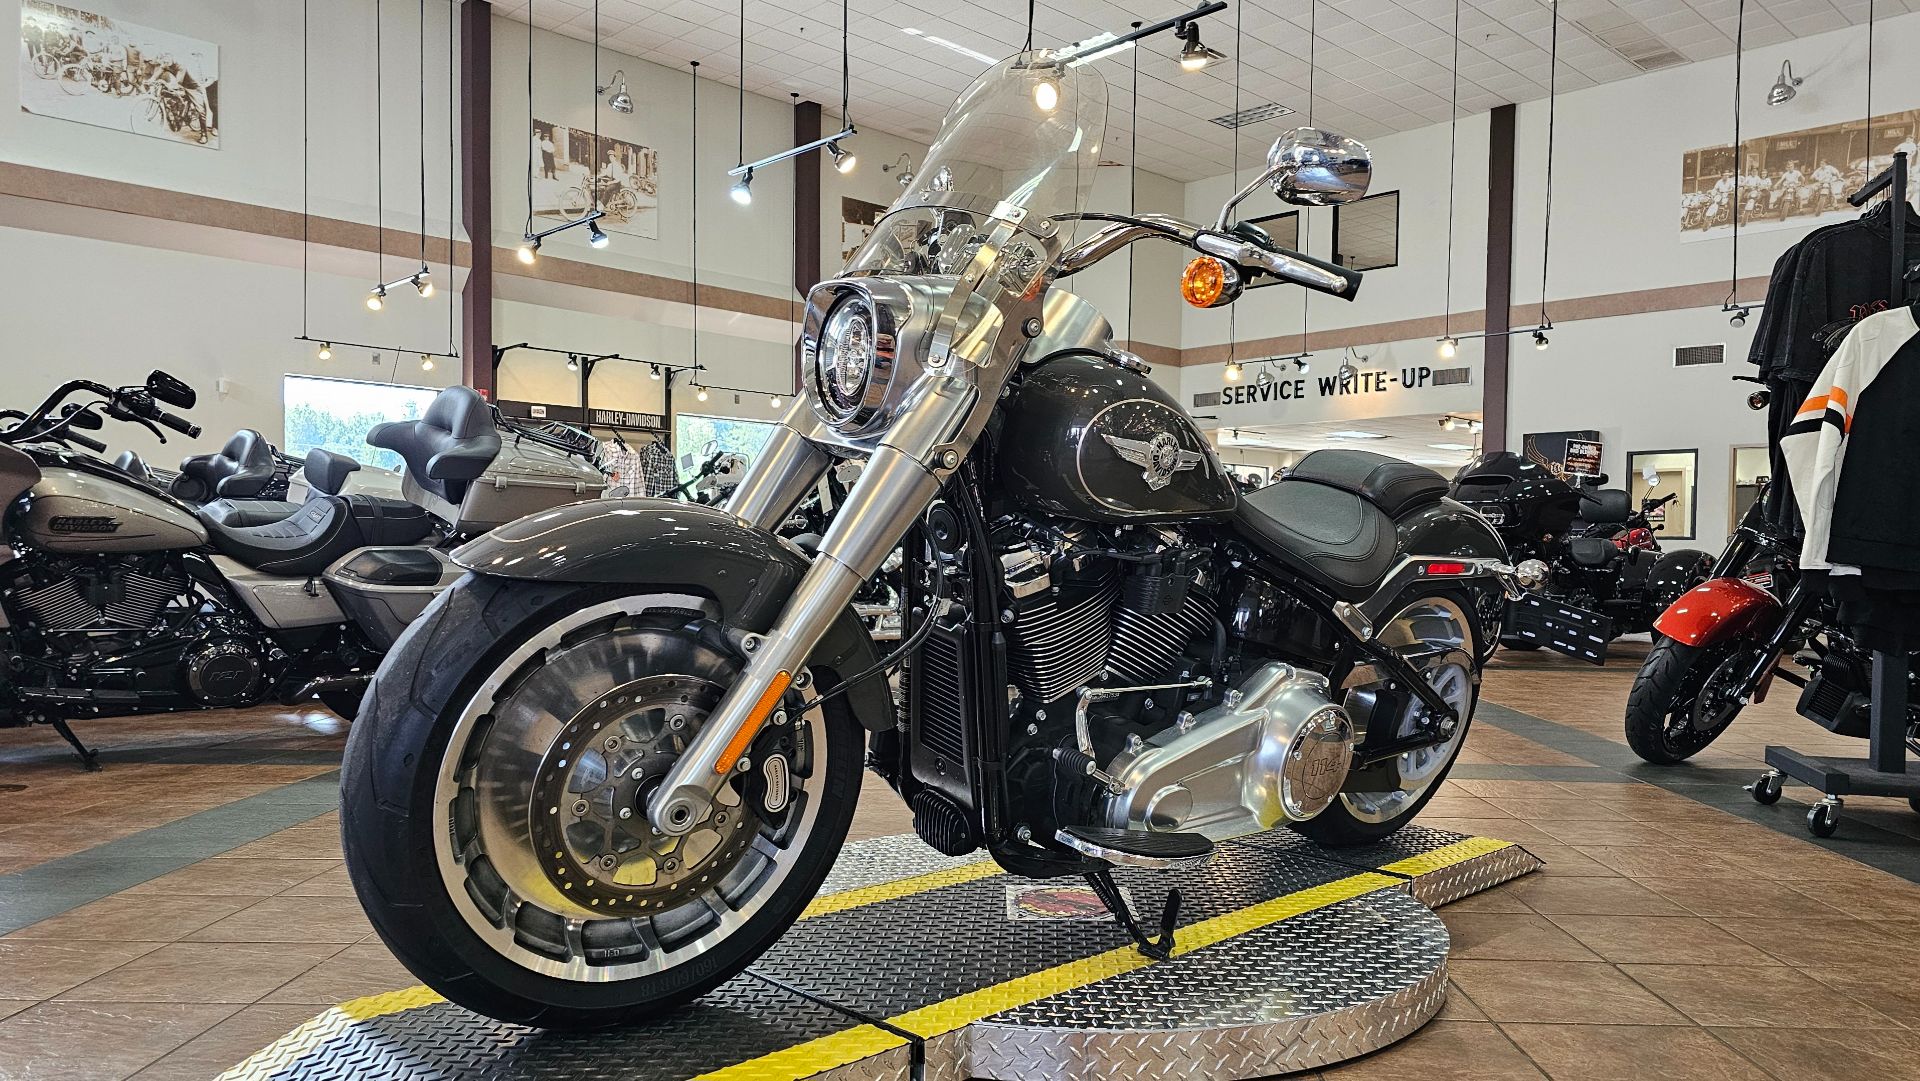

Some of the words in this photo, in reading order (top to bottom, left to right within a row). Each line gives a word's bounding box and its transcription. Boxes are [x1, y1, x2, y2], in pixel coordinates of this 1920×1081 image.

[1222, 379, 1305, 405] SERVICE
[1318, 366, 1431, 397] WRITE-UP
[595, 409, 661, 429] HARLEY-DAVIDSON
[1156, 436, 1179, 453] HARLEY
[1152, 454, 1178, 477] DAVIDSON
[1310, 757, 1342, 777] 114
